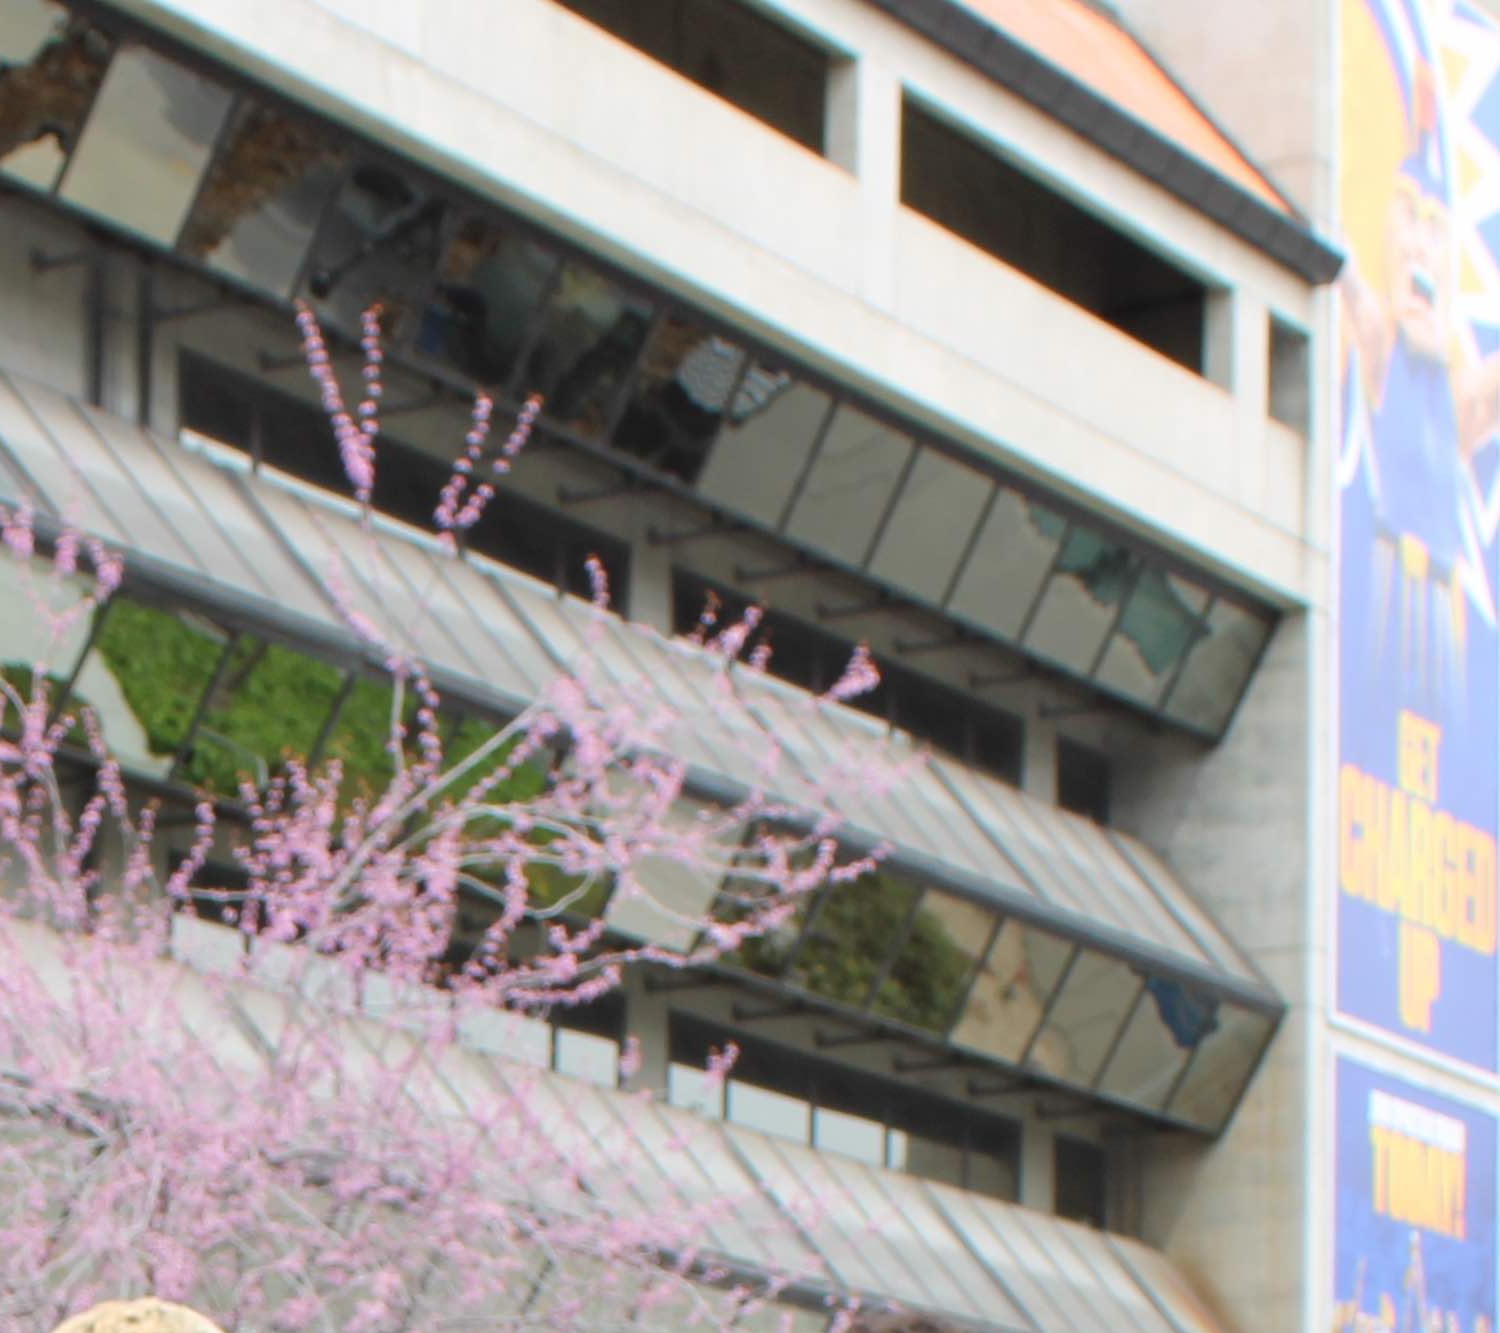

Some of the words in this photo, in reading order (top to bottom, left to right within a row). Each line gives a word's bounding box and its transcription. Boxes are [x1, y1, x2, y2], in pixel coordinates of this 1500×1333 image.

[1398, 709, 1443, 803] GET
[1340, 763, 1498, 956] CHARGED
[1399, 919, 1440, 1034] UP
